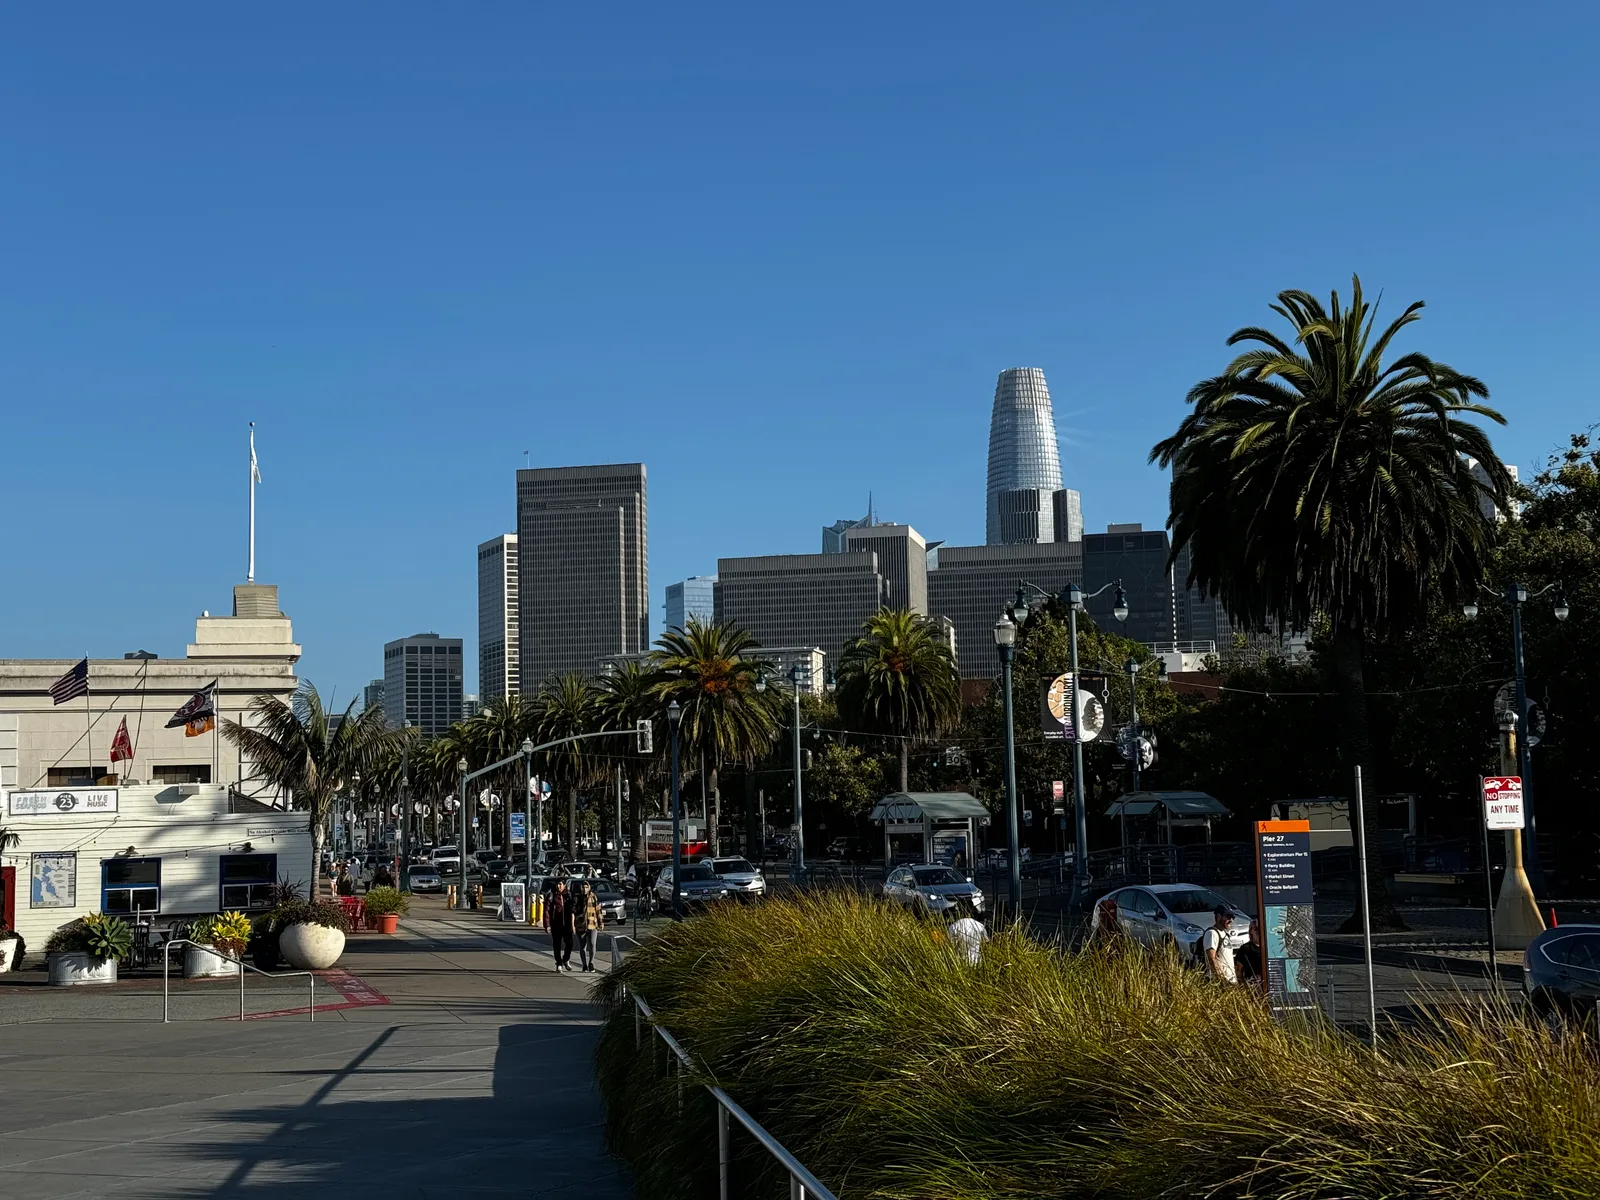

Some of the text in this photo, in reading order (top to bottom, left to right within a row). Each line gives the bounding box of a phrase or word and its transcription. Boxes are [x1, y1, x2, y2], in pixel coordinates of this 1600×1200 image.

[947, 756, 960, 764] 30
[16, 796, 47, 804] FRESH
[88, 794, 108, 802] LIVE
[1486, 792, 1521, 800] NO STOPPING
[15, 802, 47, 810] SEAFOOD
[59, 798, 73, 808] 23
[1490, 804, 1520, 814] ANY TIME
